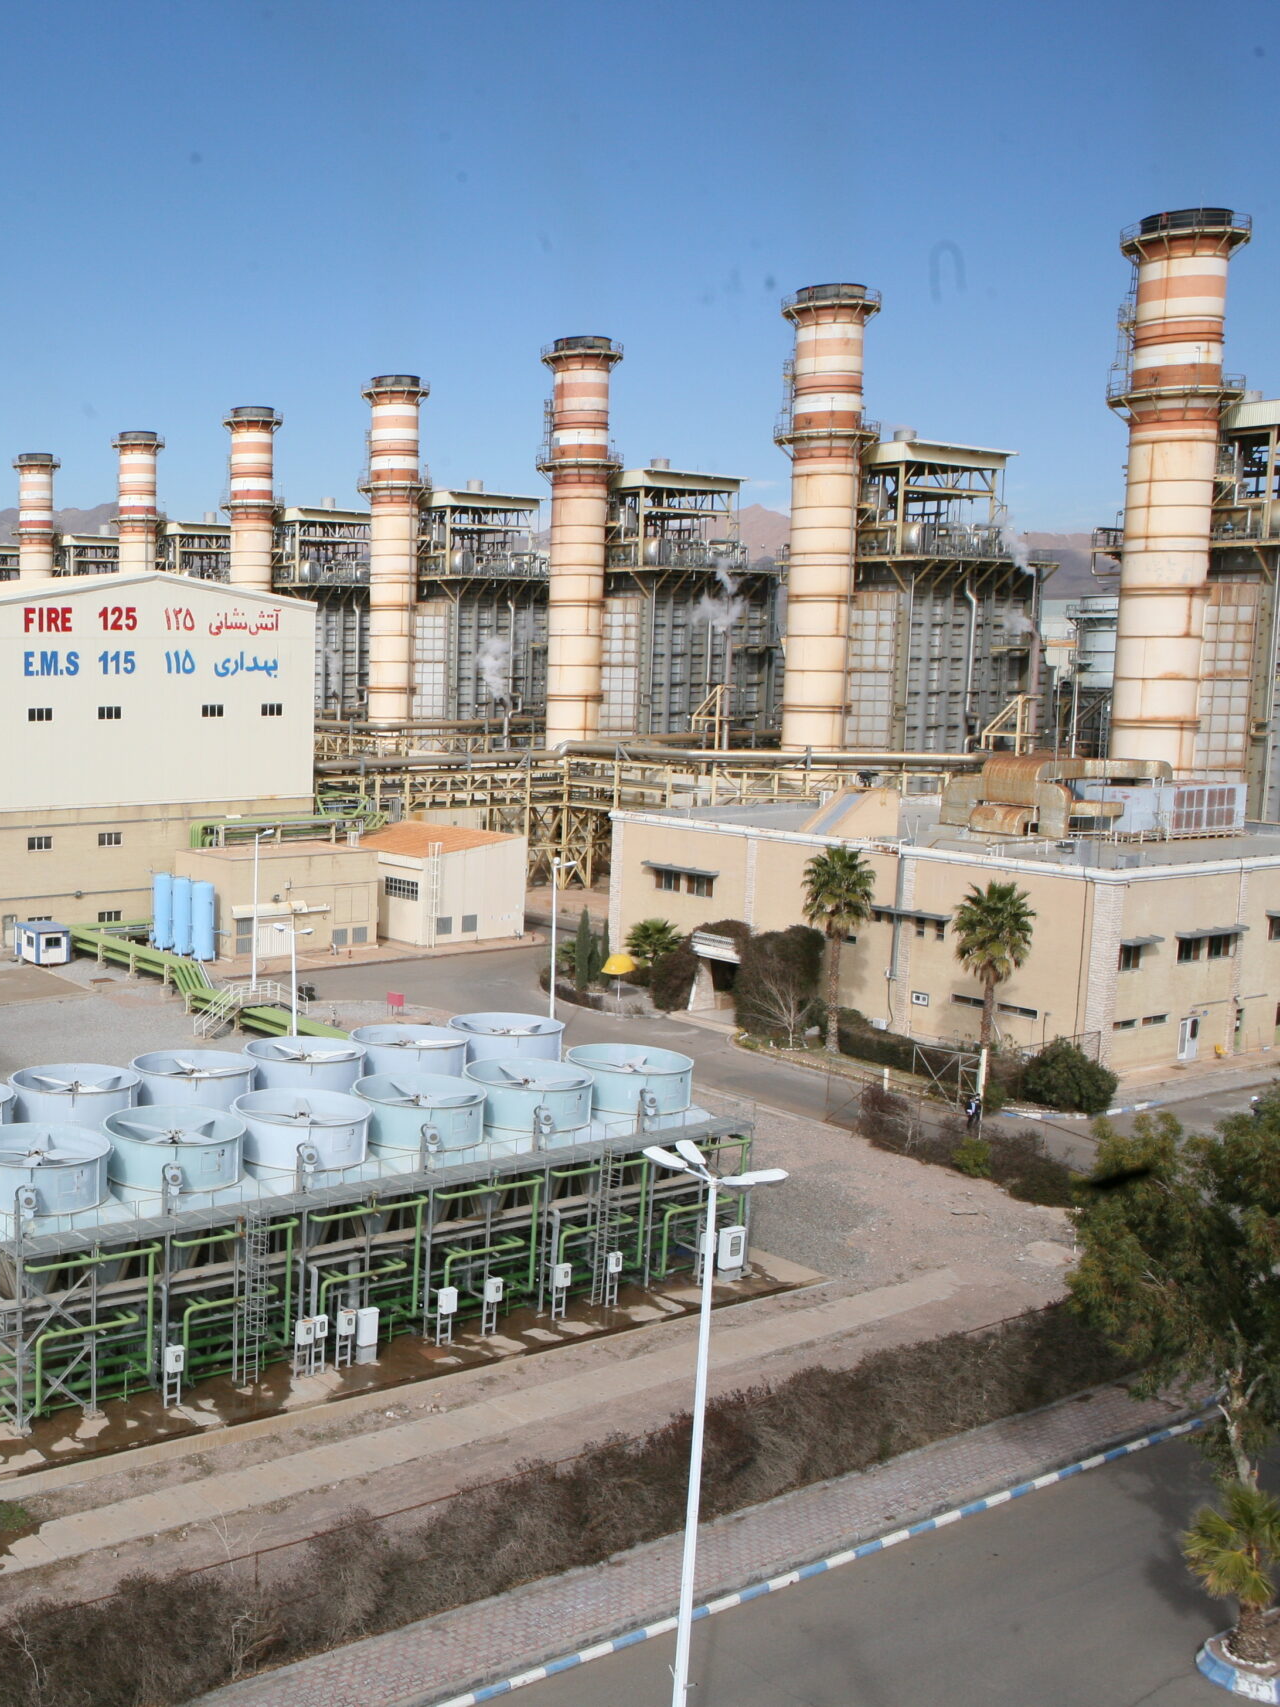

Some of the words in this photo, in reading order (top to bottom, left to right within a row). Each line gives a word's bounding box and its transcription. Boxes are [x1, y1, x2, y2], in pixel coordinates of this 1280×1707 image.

[23, 606, 73, 633] FIRE
[98, 606, 138, 632] 125
[164, 607, 195, 632] ۱۲۵
[23, 650, 80, 677] E.M.S
[98, 650, 136, 675] 115
[164, 649, 196, 675] ۱۱۵
[214, 650, 279, 679] بهداری
